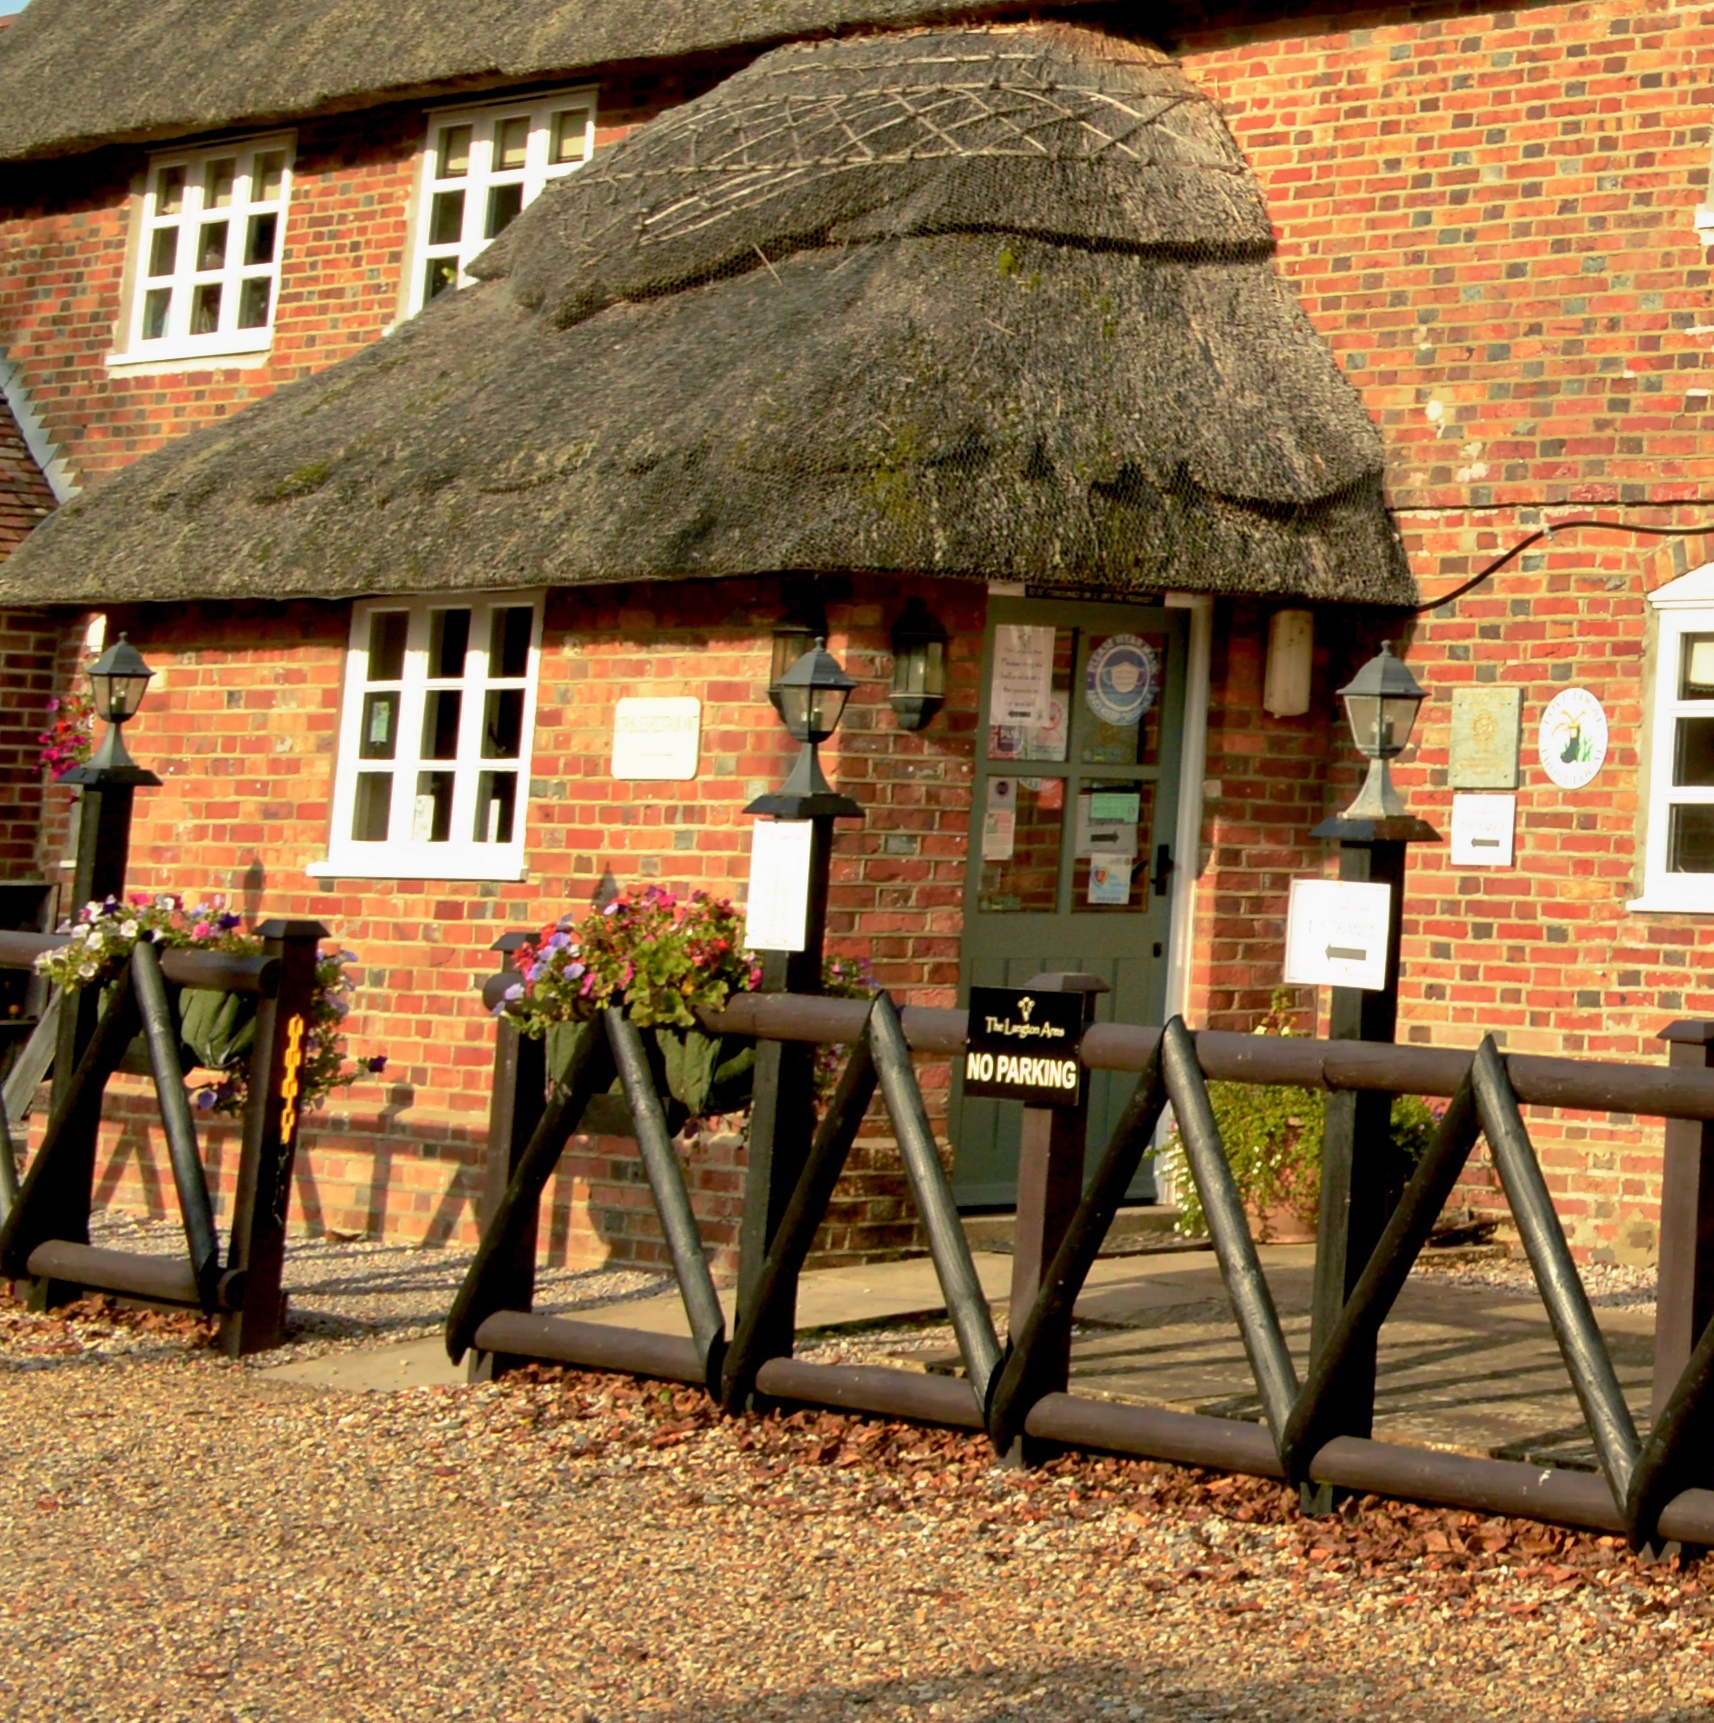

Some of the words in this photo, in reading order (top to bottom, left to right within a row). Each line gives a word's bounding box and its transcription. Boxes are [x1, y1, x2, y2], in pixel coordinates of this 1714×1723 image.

[985, 1016, 1003, 1033] The
[1004, 1018, 1039, 1039] Langton
[1039, 1021, 1065, 1038] Arms
[966, 1052, 993, 1082] NO
[996, 1055, 1076, 1089] PARKING
